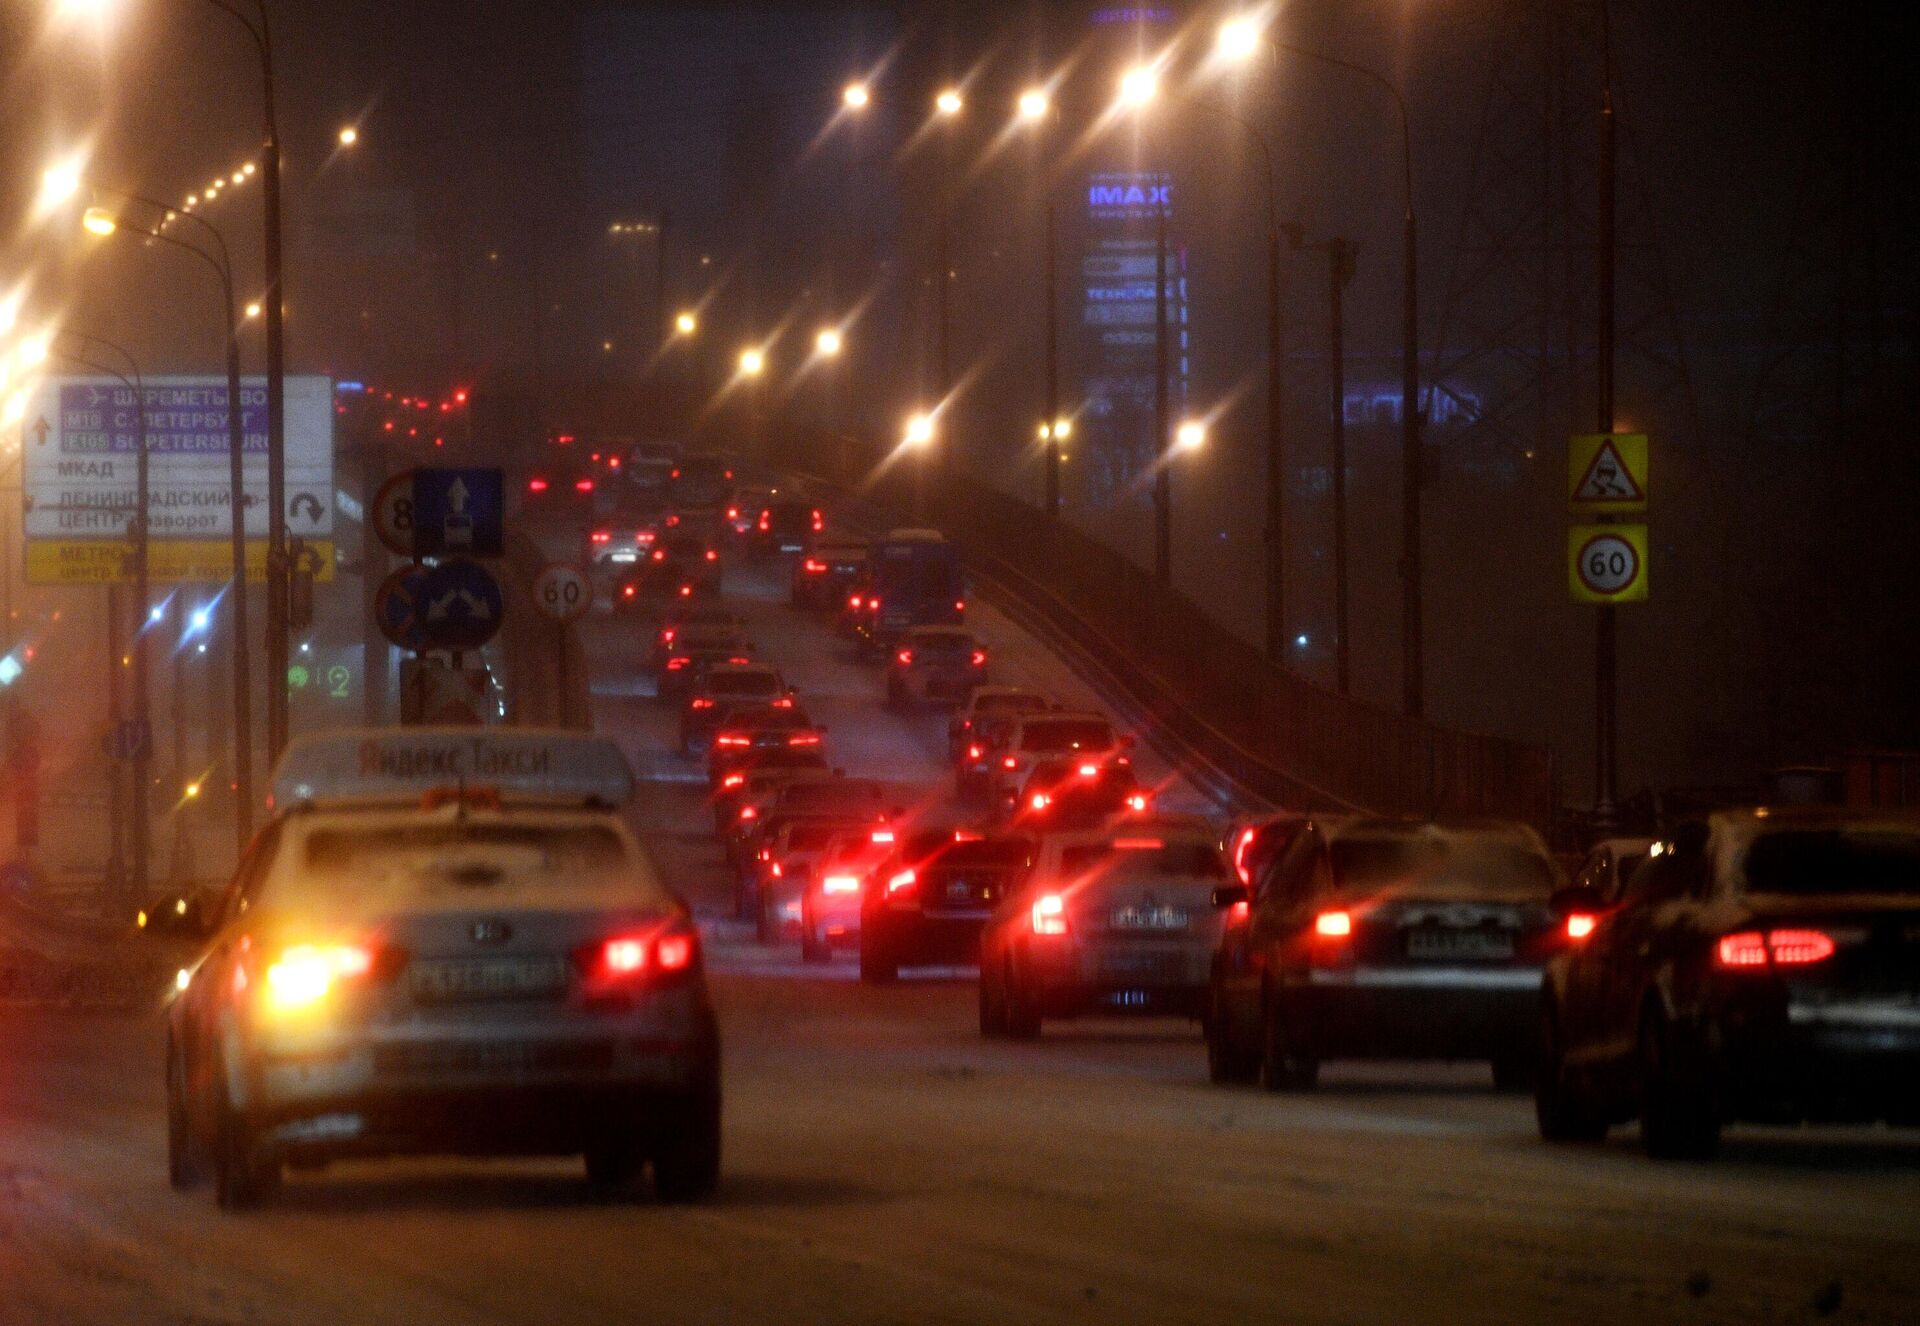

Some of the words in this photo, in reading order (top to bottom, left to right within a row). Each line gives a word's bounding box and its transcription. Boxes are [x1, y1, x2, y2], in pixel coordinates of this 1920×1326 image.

[1089, 186, 1169, 206] IMAX
[114, 389, 268, 406] ШРЕМЕТЬВО
[58, 461, 114, 478] МКАД
[60, 490, 230, 507] ЛЕНИНГАДСКИЙ
[1590, 552, 1626, 576] 60
[544, 581, 580, 604] 60
